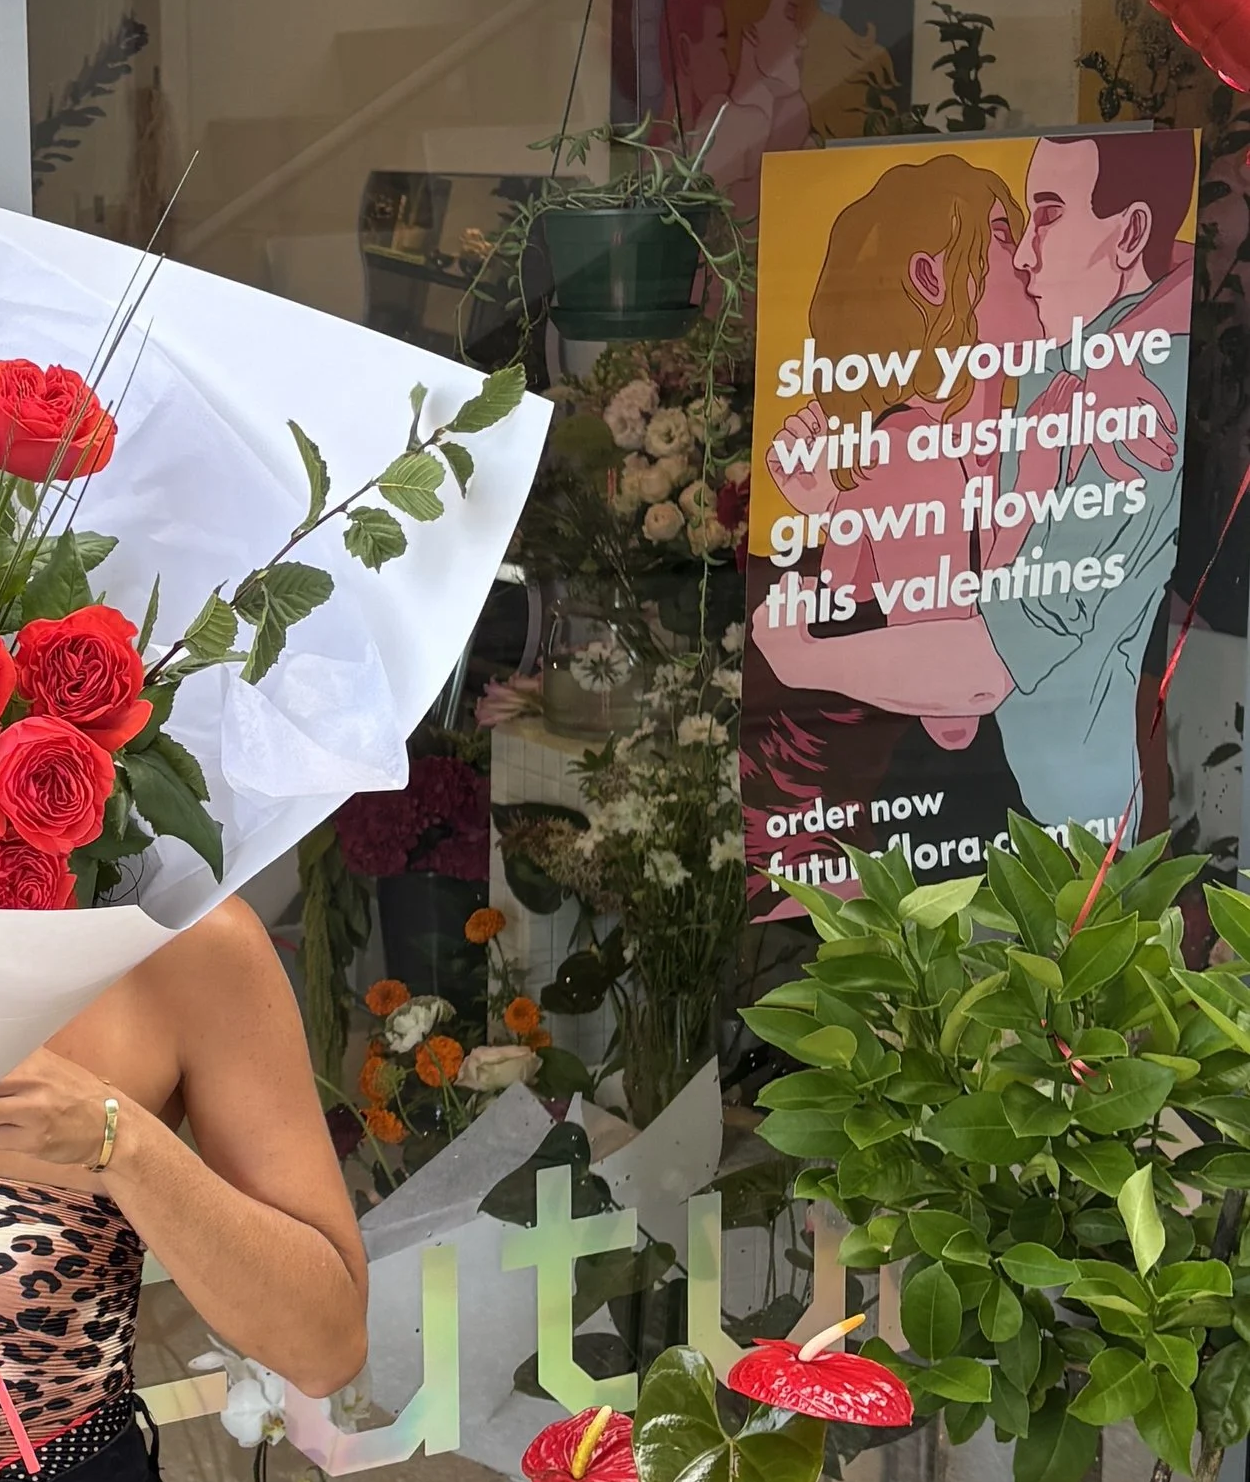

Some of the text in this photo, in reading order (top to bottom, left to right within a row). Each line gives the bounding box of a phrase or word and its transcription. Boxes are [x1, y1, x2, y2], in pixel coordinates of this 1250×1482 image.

[776, 316, 1172, 400] show your love
[772, 391, 1157, 475] with australian
[769, 476, 1147, 568] grown flowers
[766, 545, 1126, 628] this valentines
[765, 790, 945, 838] order now
